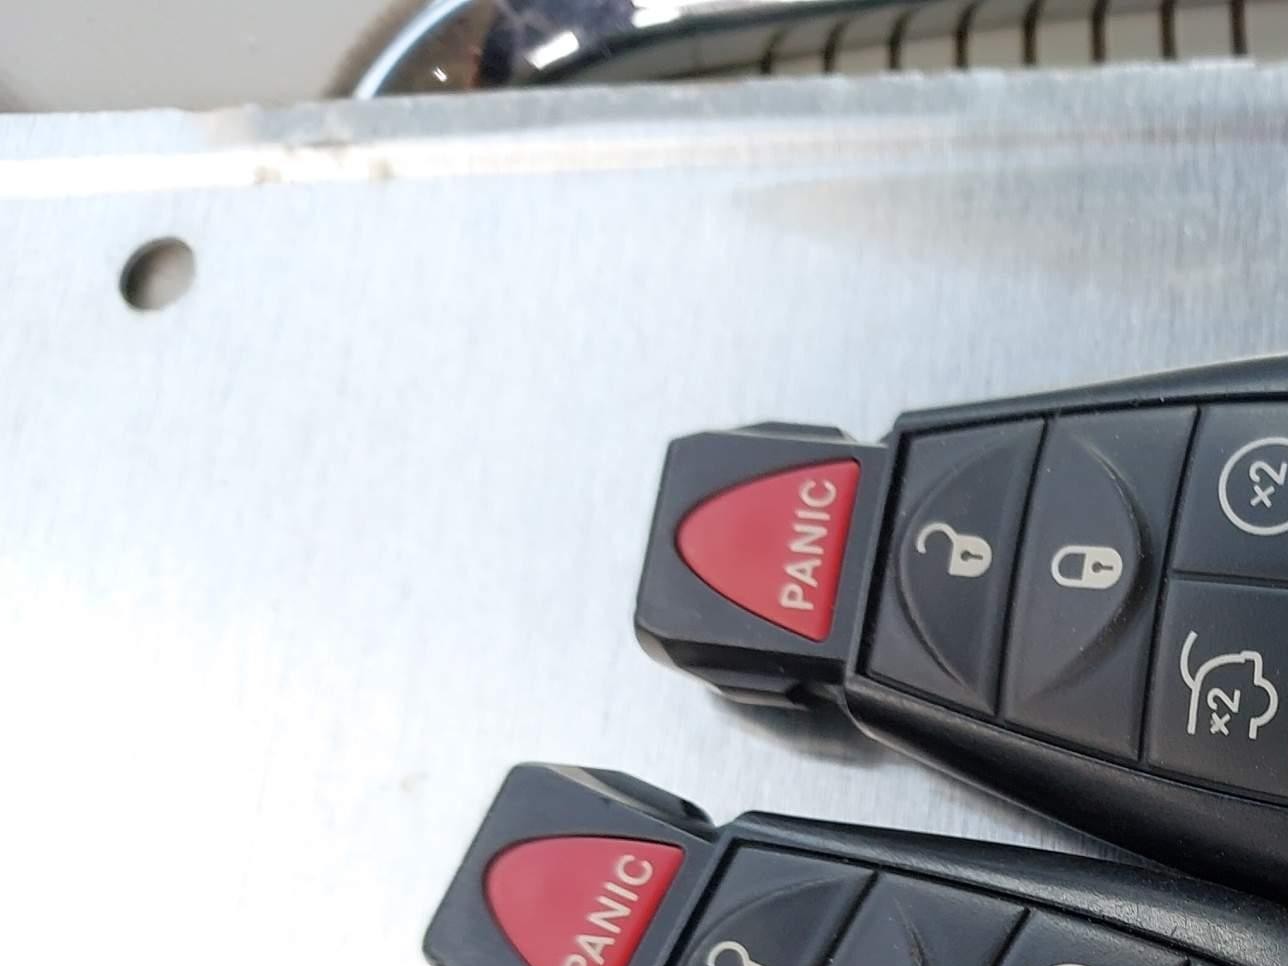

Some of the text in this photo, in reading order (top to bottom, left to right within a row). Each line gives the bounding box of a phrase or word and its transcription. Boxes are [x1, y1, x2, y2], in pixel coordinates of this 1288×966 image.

[1249, 460, 1288, 508] x2
[779, 480, 836, 611] PANIC
[1207, 687, 1241, 735] x2
